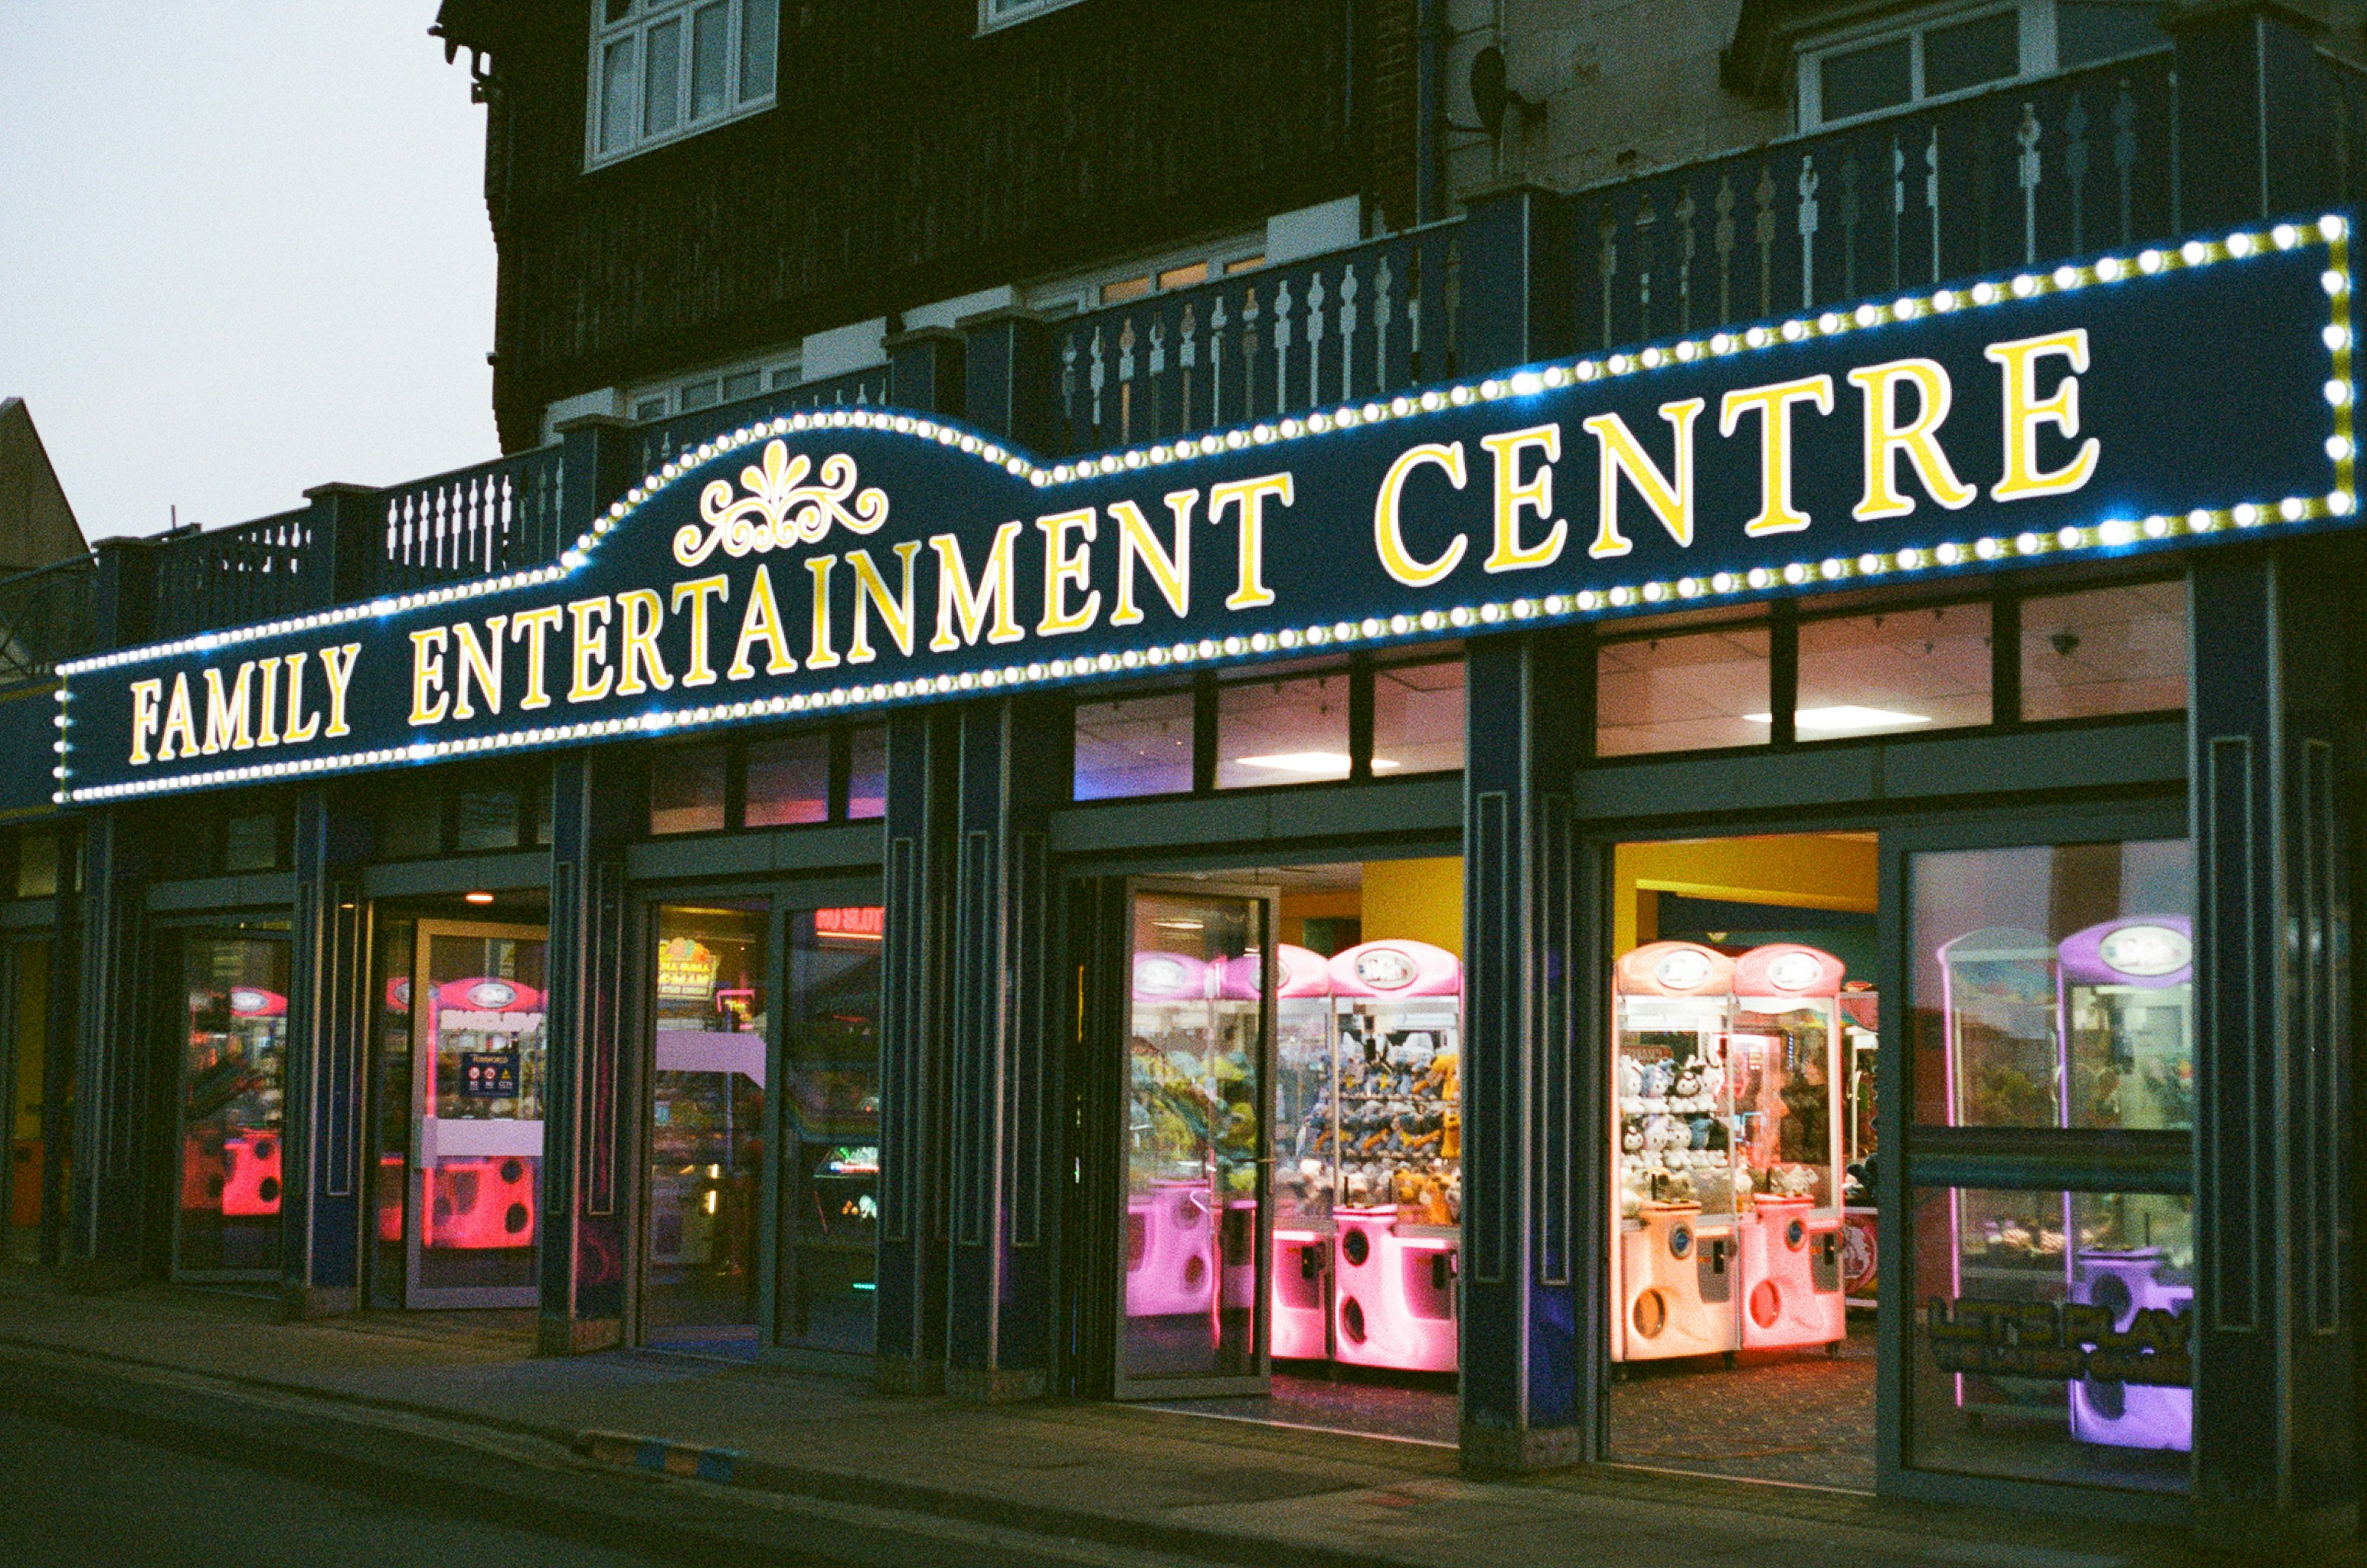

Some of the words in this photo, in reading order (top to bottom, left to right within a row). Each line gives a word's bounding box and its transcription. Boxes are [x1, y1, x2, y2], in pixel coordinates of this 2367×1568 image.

[129, 642, 361, 765] FAMILY
[408, 472, 1294, 726] ENTERTAINMENT
[1374, 328, 2101, 588] CENTRE
